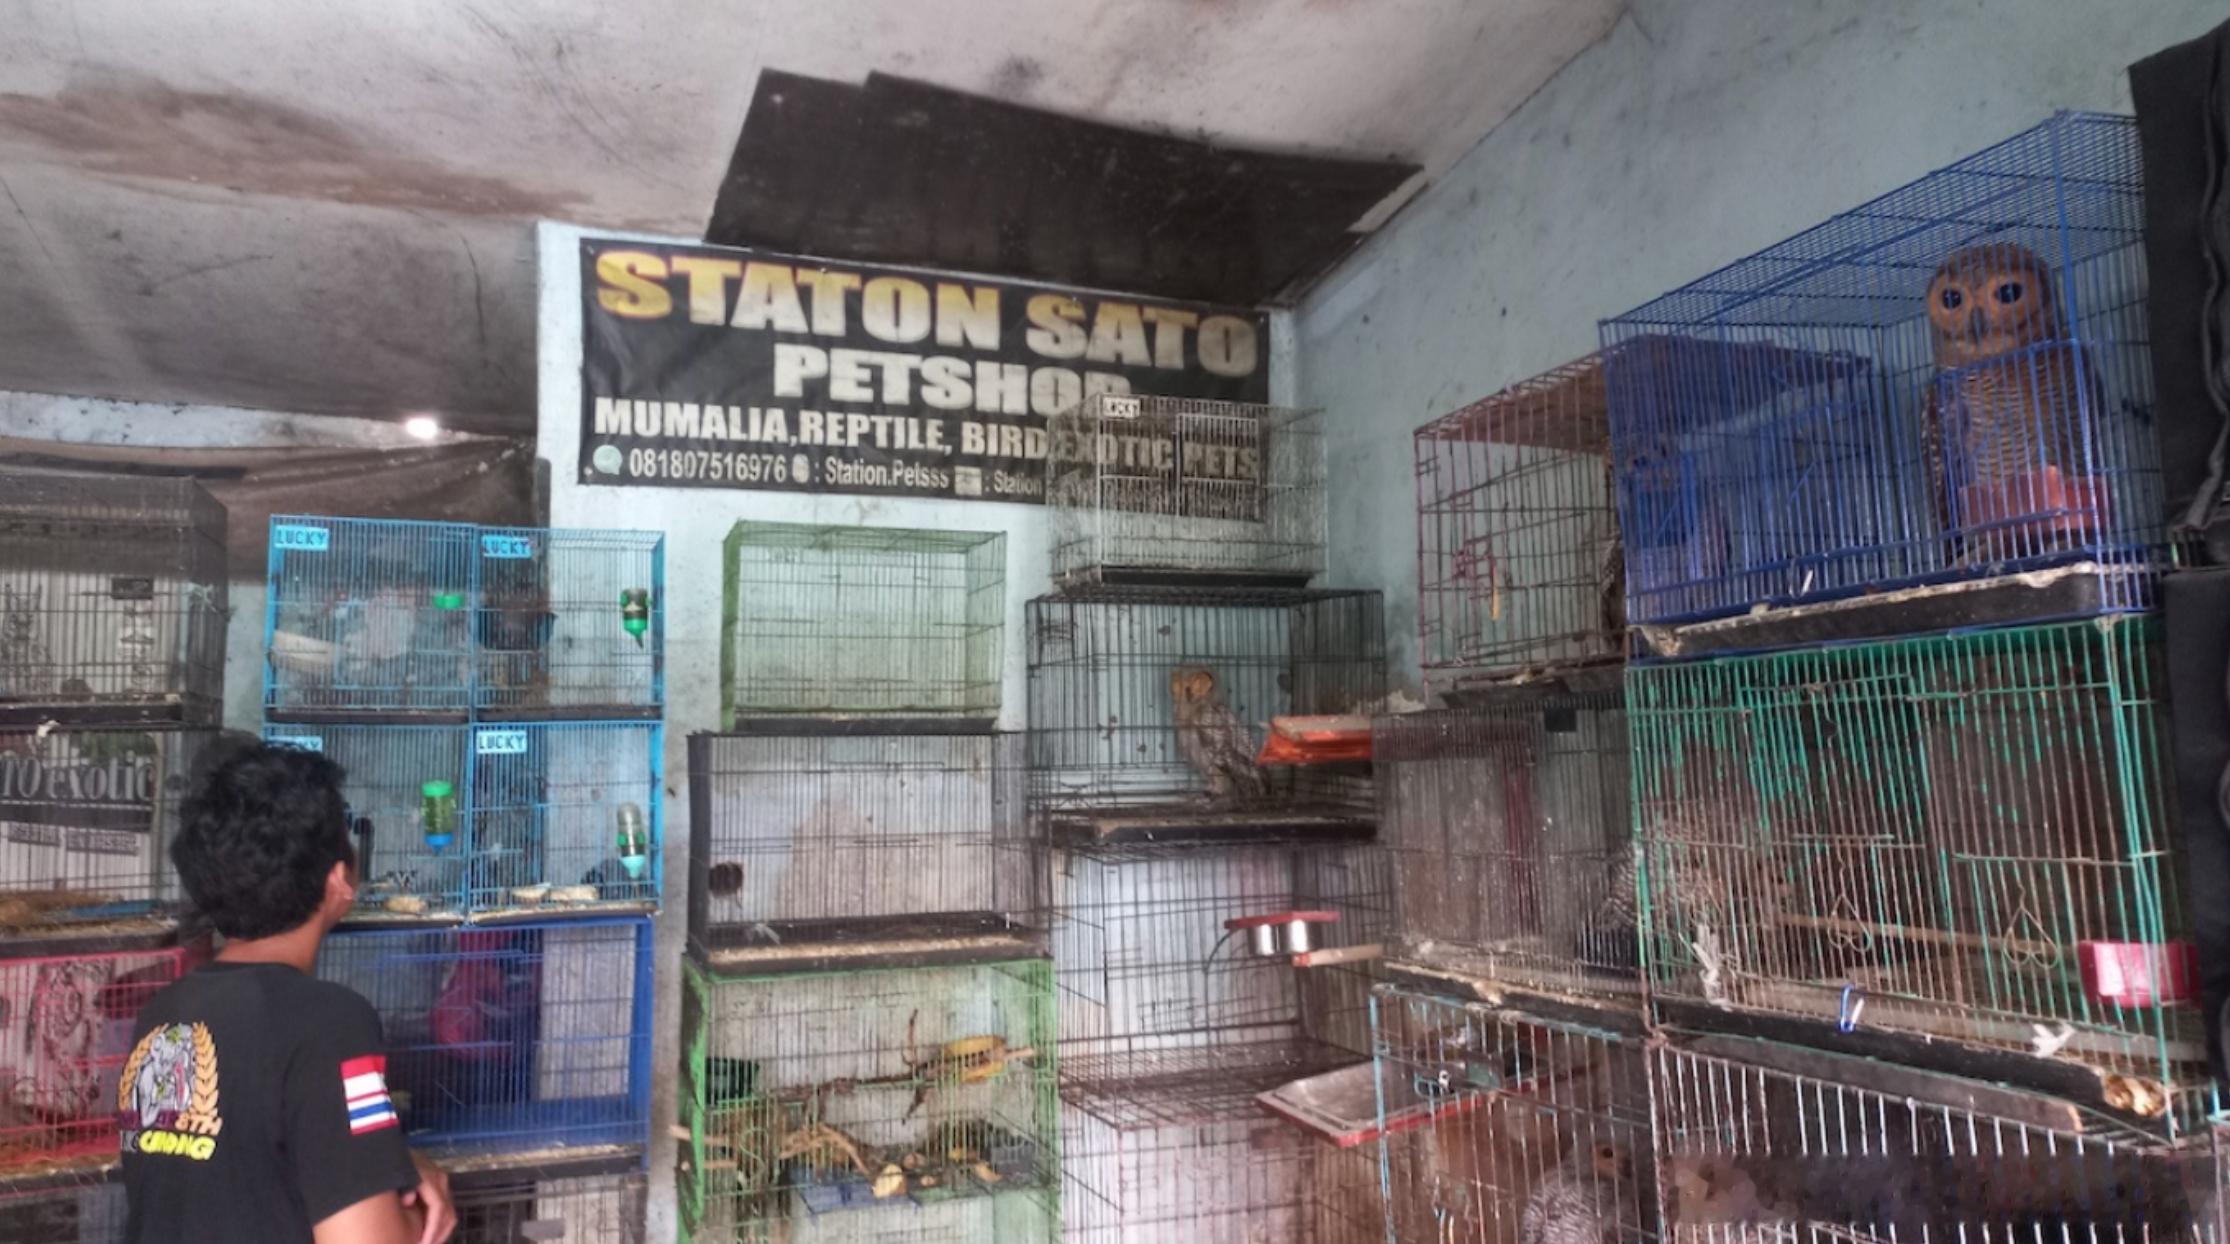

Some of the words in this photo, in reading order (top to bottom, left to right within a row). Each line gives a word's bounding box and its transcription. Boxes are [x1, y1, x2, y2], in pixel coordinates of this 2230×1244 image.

[596, 251, 1000, 351] STATON
[1026, 294, 1257, 378] SATO
[629, 448, 787, 484] 081807516976
[276, 529, 326, 546] LUCKY
[479, 735, 524, 750] LUCKY
